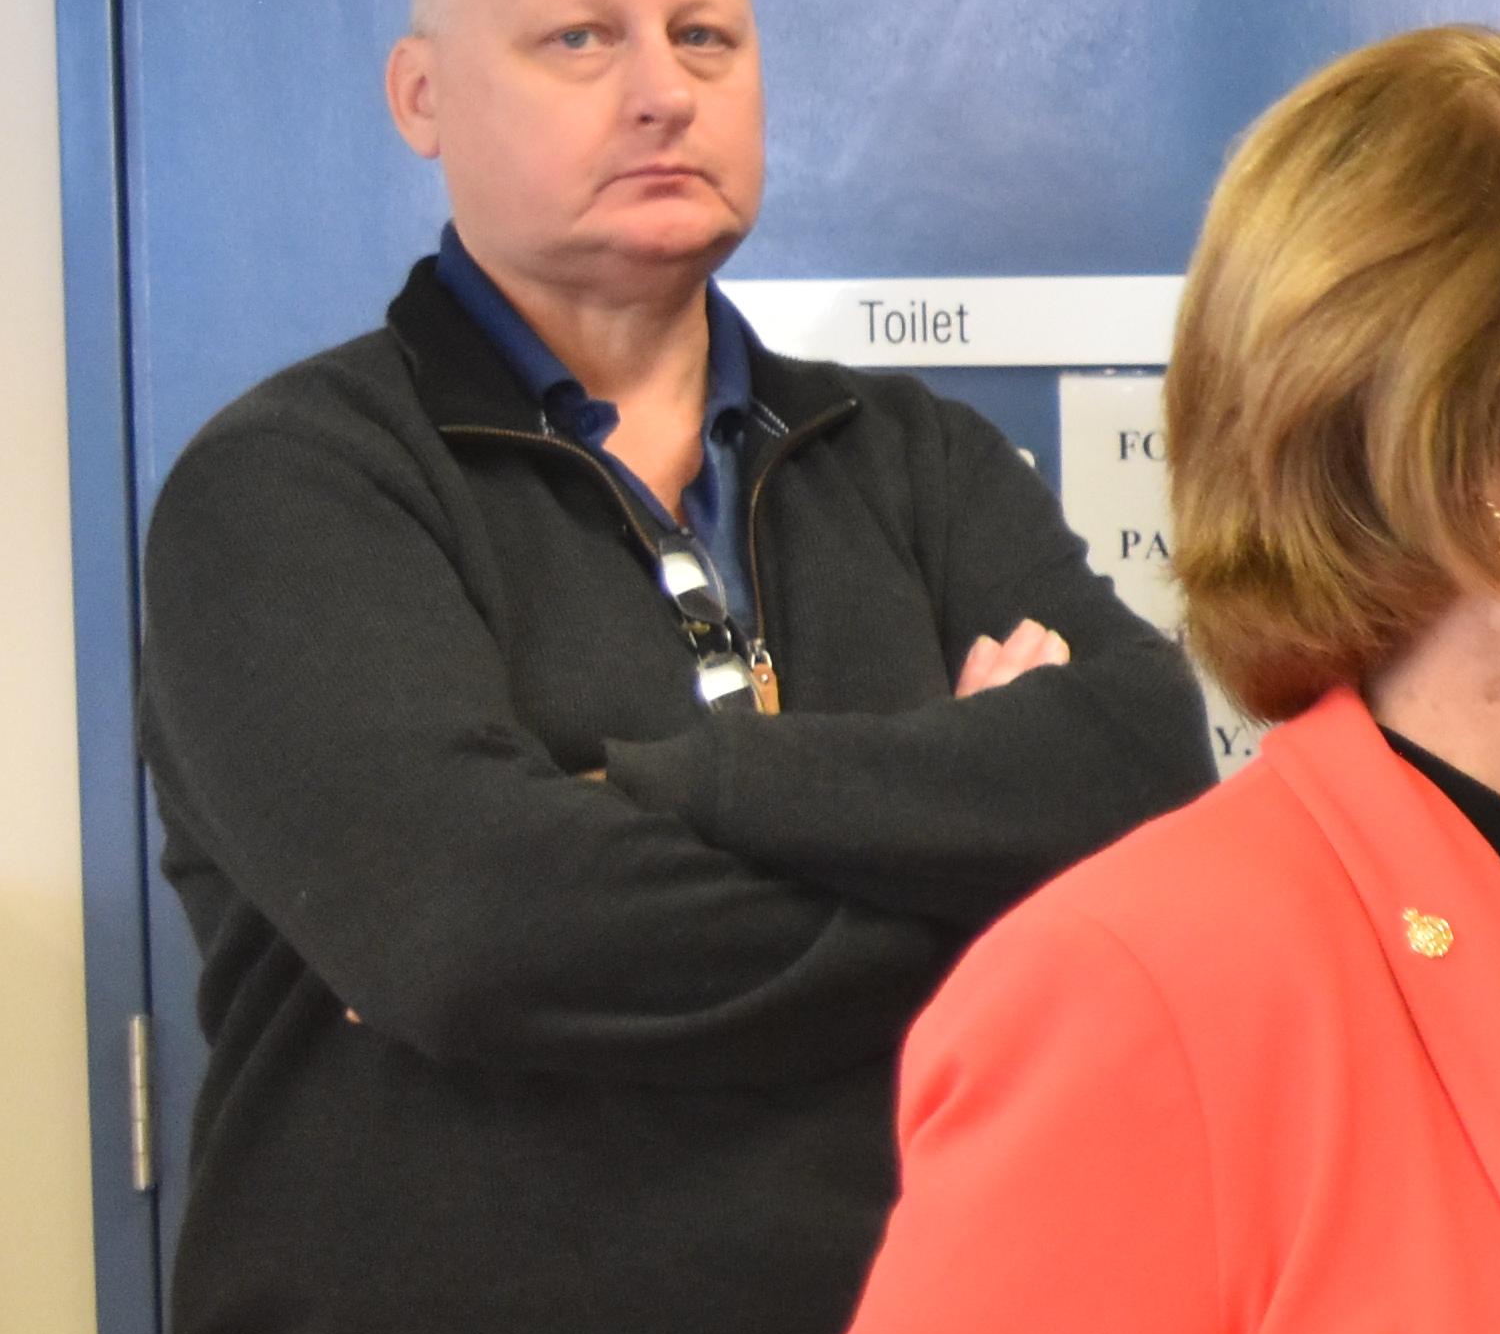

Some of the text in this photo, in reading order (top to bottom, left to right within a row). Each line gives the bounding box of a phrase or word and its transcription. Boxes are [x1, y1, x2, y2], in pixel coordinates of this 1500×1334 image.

[859, 300, 970, 344] Toilet
[1119, 431, 1168, 461] FO
[1120, 530, 1170, 560] PA
[1214, 726, 1252, 756] Y.
